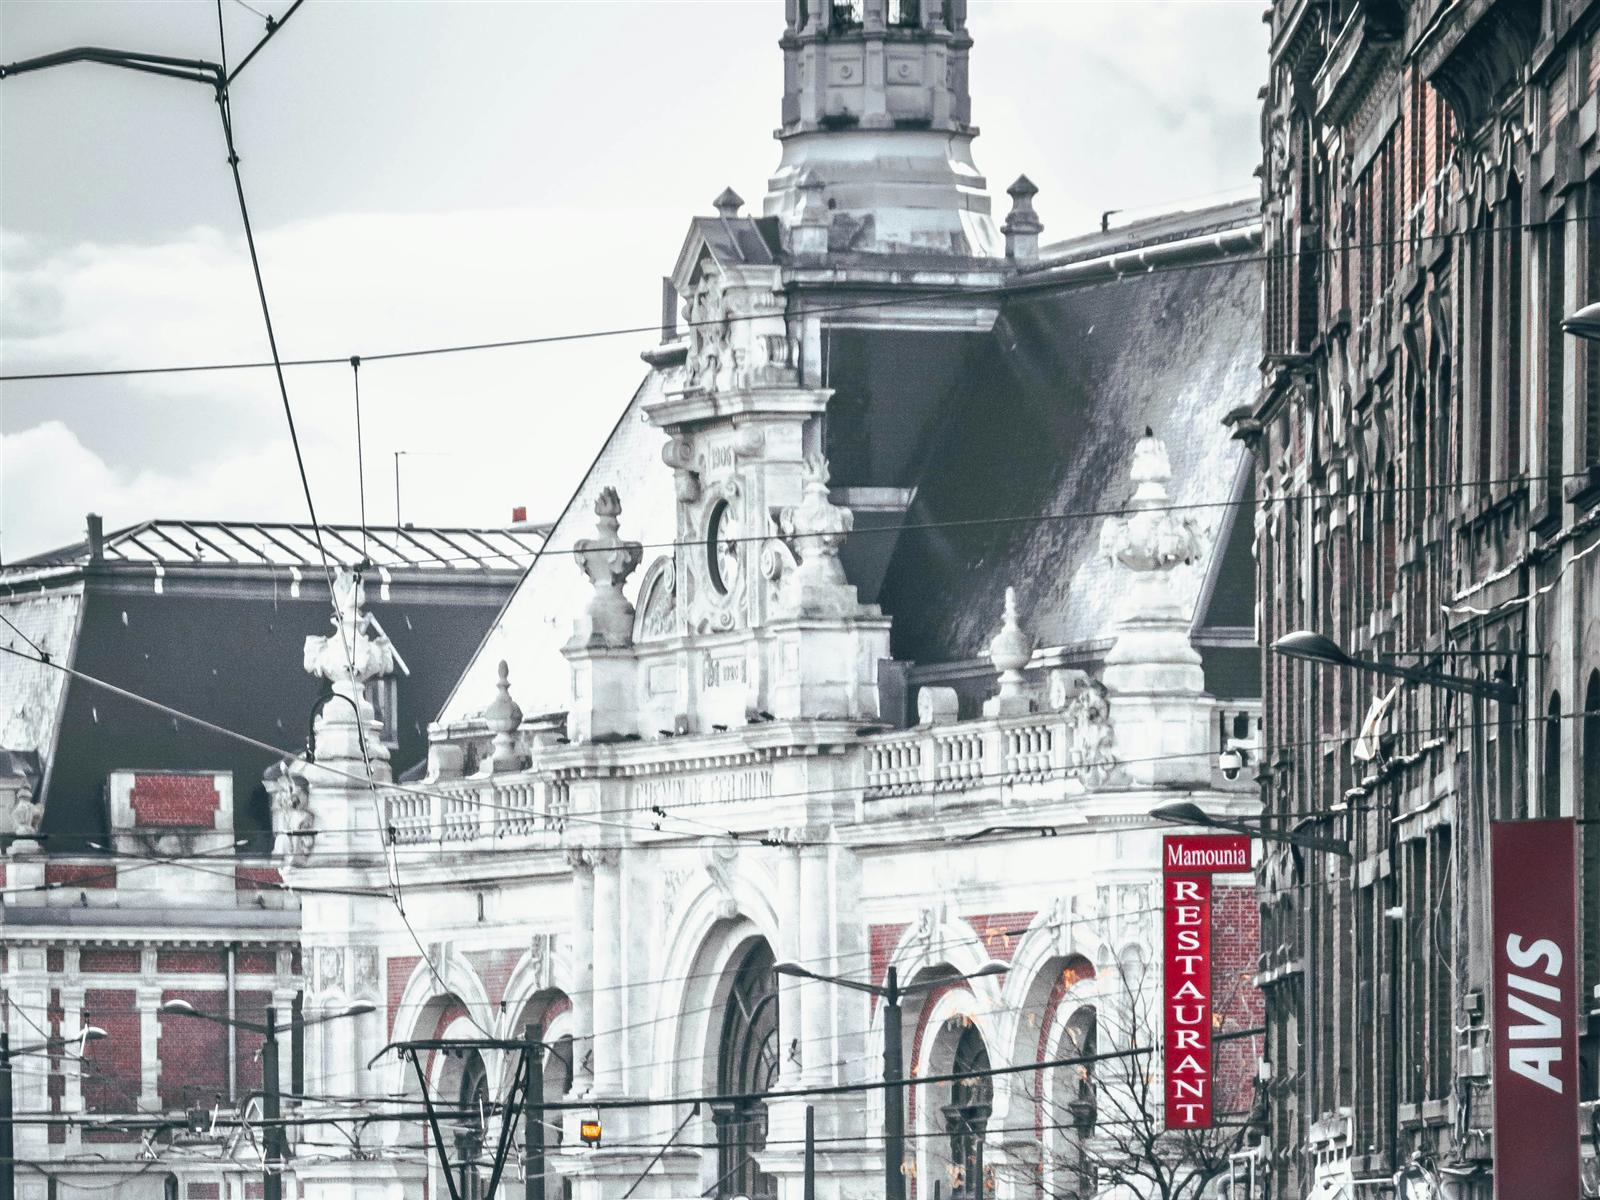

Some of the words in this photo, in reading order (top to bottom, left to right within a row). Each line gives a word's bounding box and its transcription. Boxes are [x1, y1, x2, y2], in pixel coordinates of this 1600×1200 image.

[1168, 843, 1246, 867] Mamounia
[1173, 881, 1206, 1124] RESTAURANT
[1505, 932, 1563, 1094] AVIS
